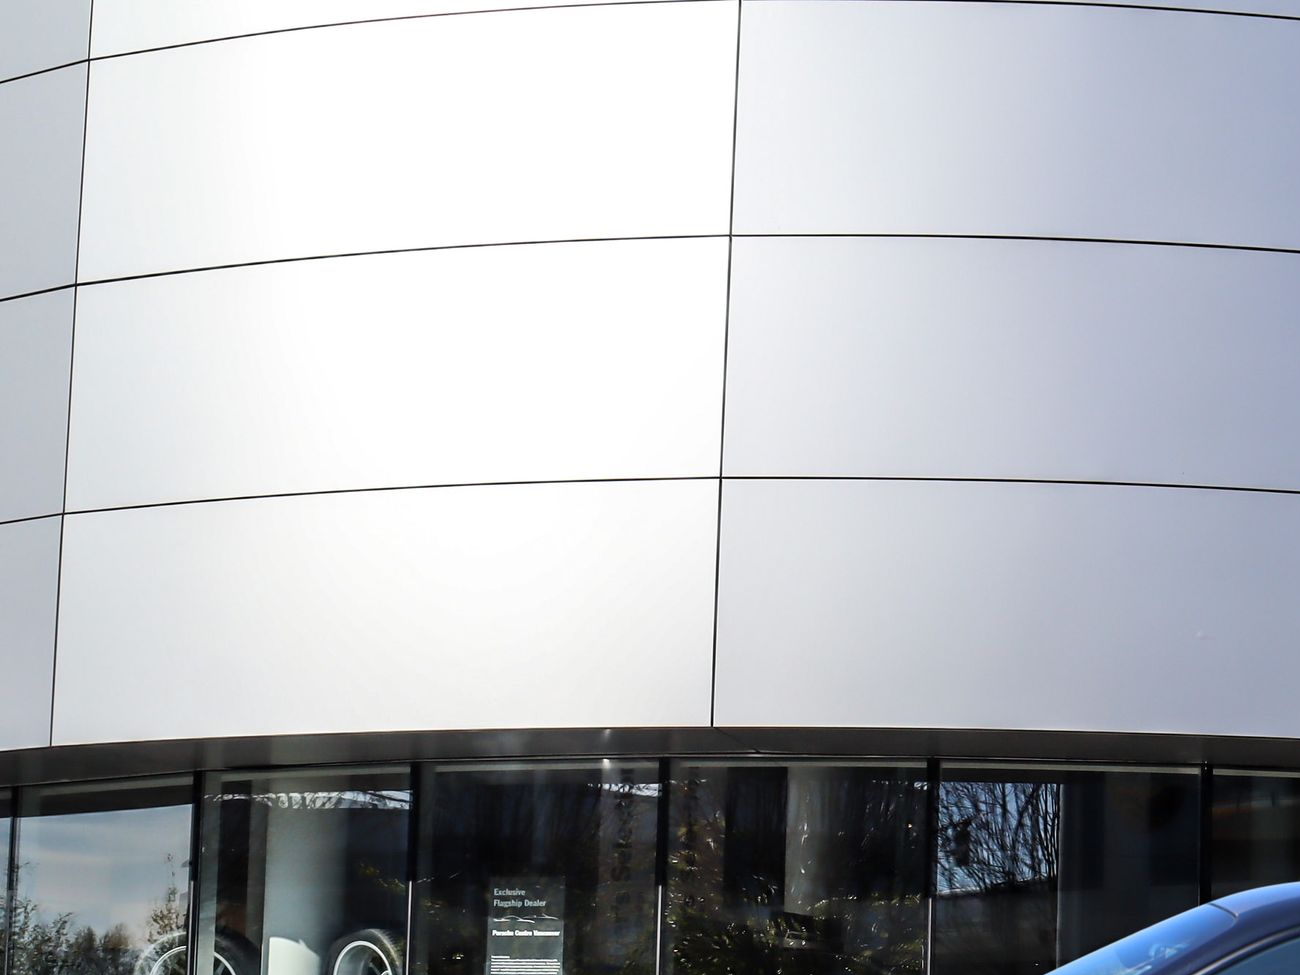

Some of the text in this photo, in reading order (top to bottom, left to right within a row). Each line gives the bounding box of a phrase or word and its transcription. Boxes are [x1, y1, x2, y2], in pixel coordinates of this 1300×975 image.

[493, 888, 526, 896] Exclusive
[493, 899, 547, 908] Flagship Dealer
